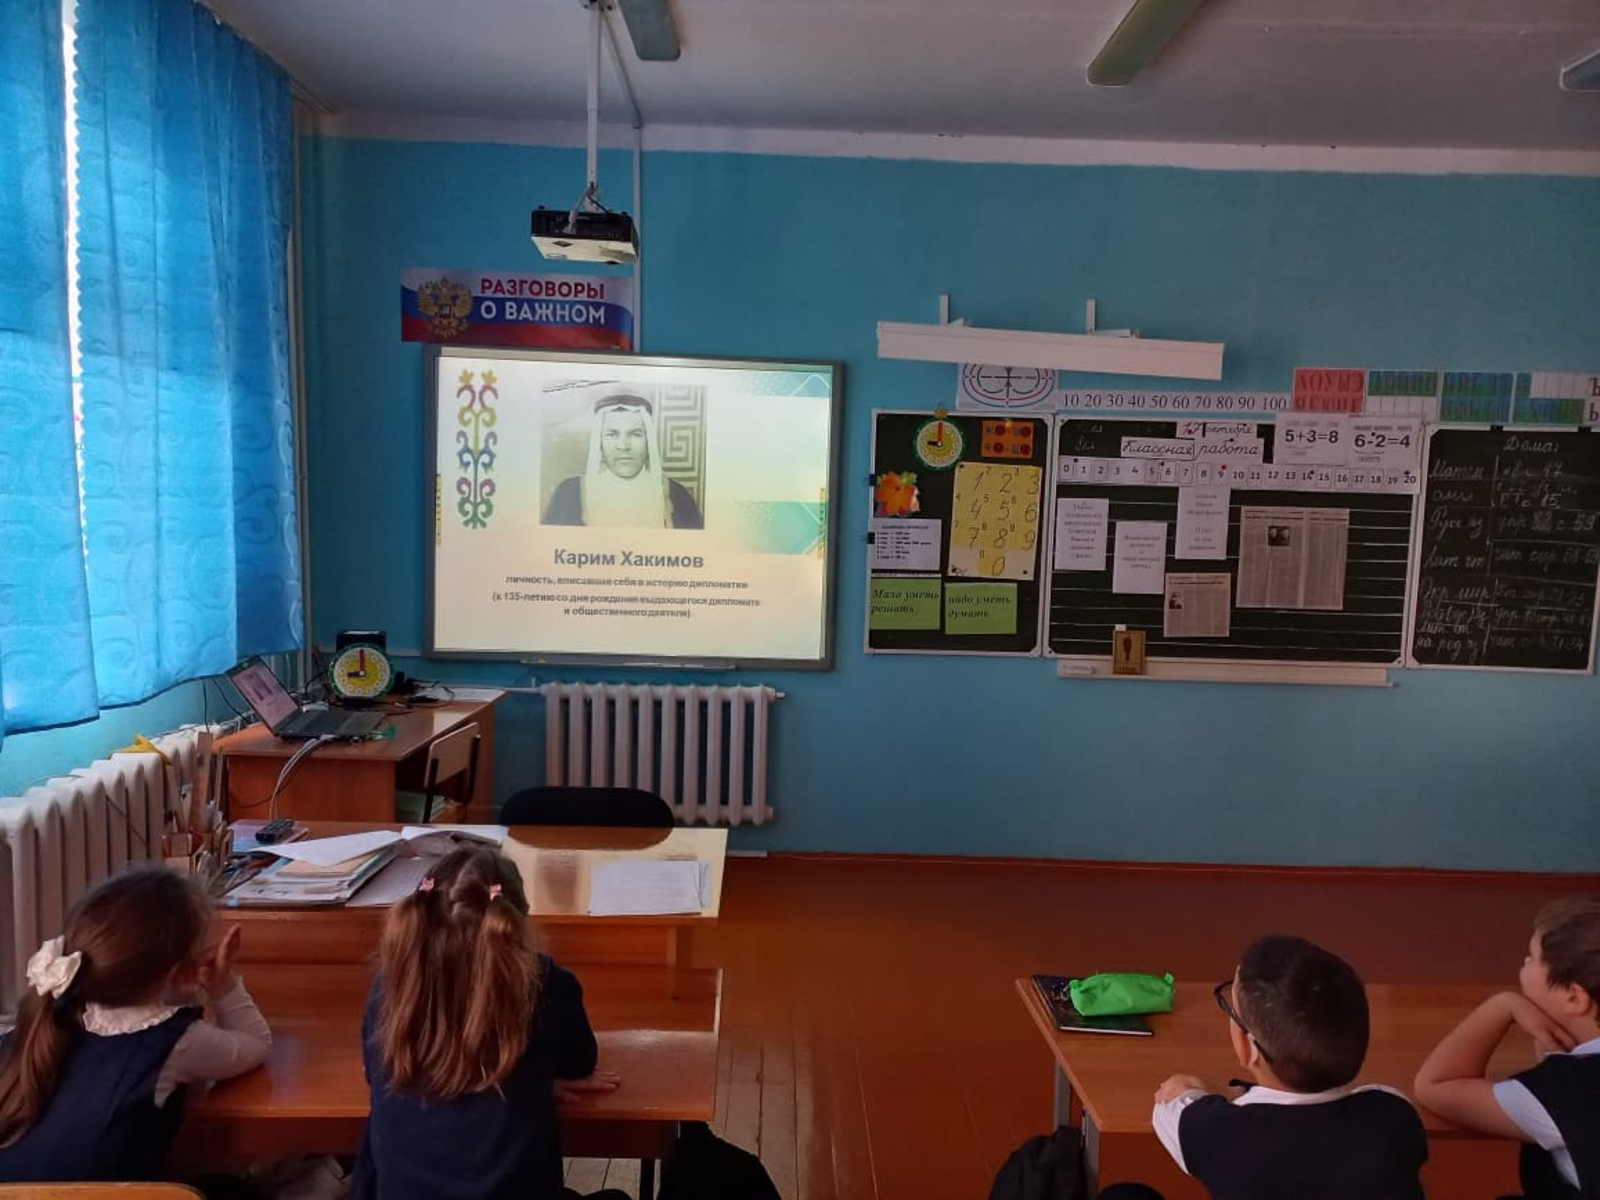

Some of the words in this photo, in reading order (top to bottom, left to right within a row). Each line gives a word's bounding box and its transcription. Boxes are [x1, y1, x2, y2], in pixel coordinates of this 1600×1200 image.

[480, 277, 605, 299] РАЗГОВОРЫ
[481, 301, 497, 319] О
[504, 301, 606, 324] ВАЖНОМ
[1063, 393, 1080, 407] 10
[1084, 394, 1101, 408] 20
[1106, 394, 1123, 408] 30
[1127, 394, 1146, 409] 40
[1150, 395, 1168, 409] 50
[1172, 395, 1190, 410] 60
[1194, 395, 1212, 410] 70
[1216, 396, 1234, 410] 80
[1238, 396, 1256, 410] 90
[1262, 396, 1287, 411] 100
[1121, 439, 1194, 456] Классная
[1196, 437, 1259, 460] работа
[999, 472, 1013, 493] 2
[1027, 474, 1040, 495] 3
[1233, 470, 1244, 479] 10
[1250, 471, 1261, 480] 11
[1268, 470, 1279, 479] 12
[1285, 471, 1296, 480] 13
[1337, 474, 1349, 483] 16
[1354, 475, 1364, 484] 17
[1371, 475, 1382, 484] 18
[1404, 475, 1417, 484] 20
[970, 498, 983, 520] 4
[997, 500, 1010, 521] 5
[1025, 502, 1038, 523] 6
[969, 526, 980, 547] 7
[993, 528, 1008, 548] 8
[1021, 529, 1036, 550] 9
[554, 549, 616, 568] Карим
[620, 550, 705, 568] Хакимов
[992, 555, 1006, 576] 0
[505, 576, 556, 586] личность,
